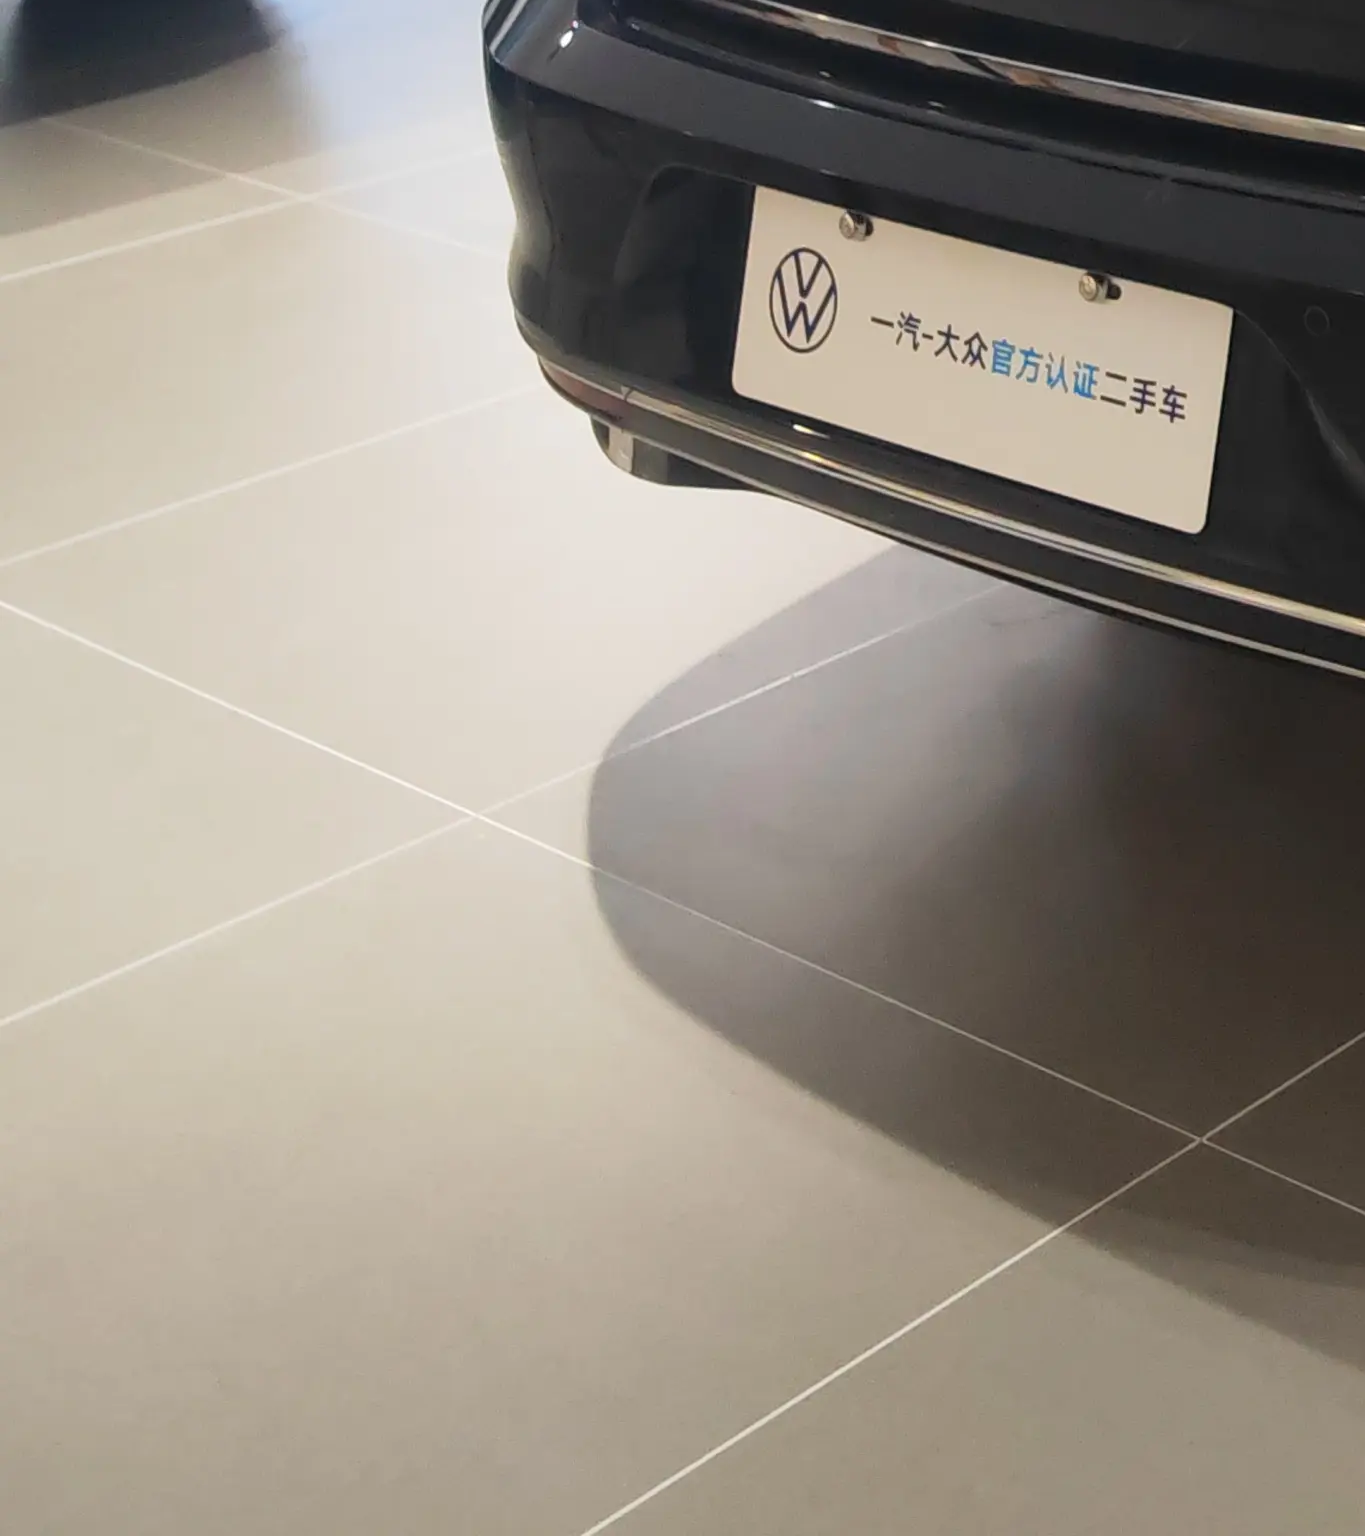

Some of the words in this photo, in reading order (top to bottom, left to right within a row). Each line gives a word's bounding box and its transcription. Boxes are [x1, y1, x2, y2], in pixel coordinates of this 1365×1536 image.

[870, 310, 1187, 424] 一汽-大众官方认证二手车
